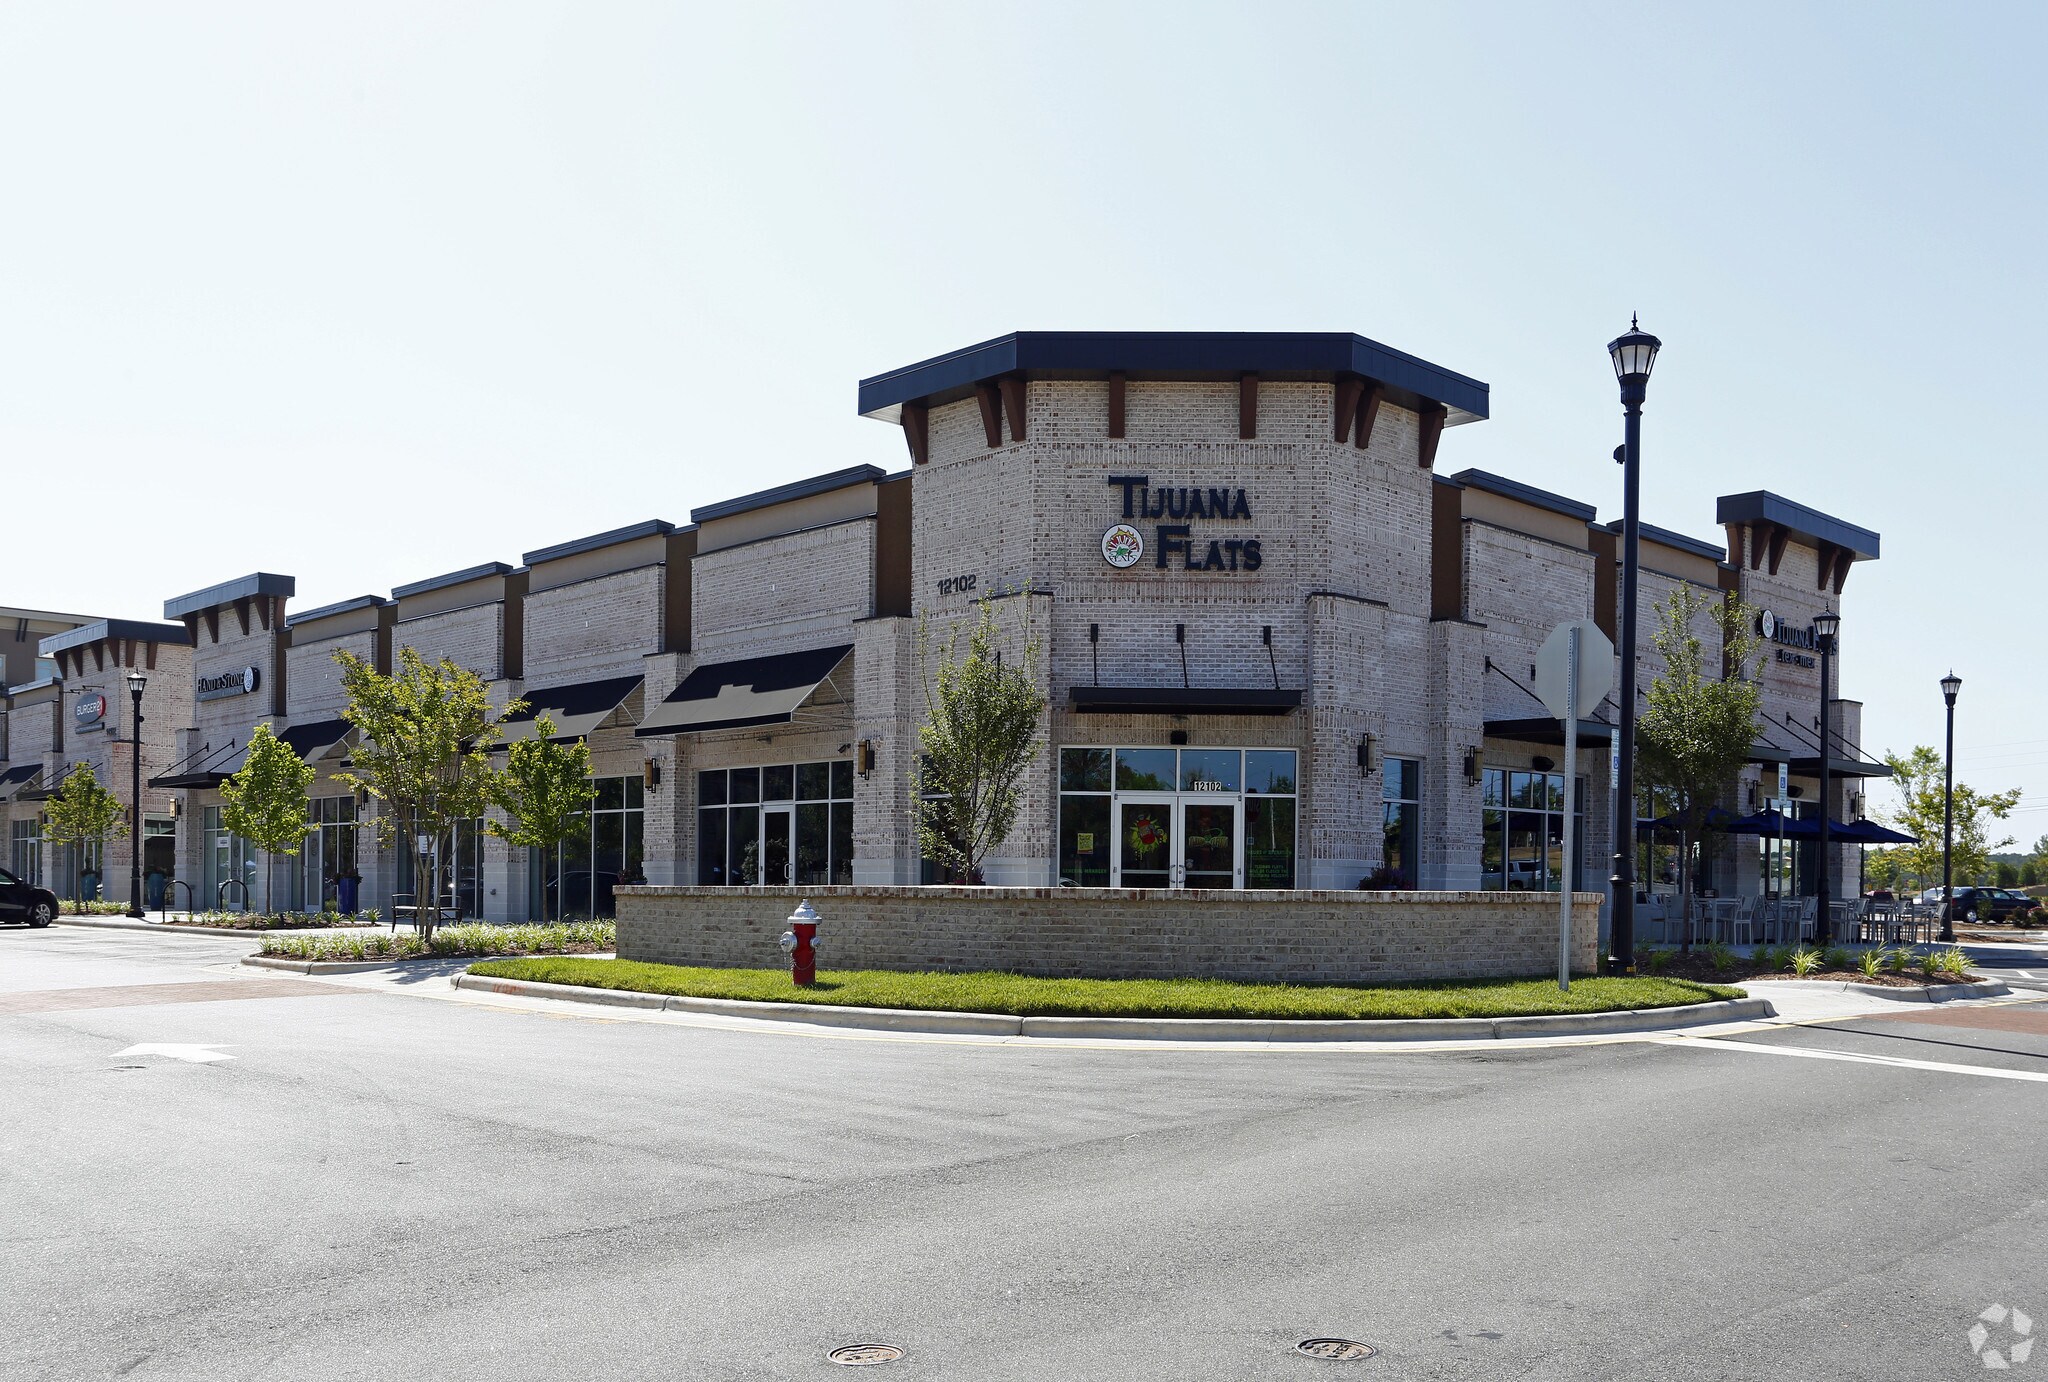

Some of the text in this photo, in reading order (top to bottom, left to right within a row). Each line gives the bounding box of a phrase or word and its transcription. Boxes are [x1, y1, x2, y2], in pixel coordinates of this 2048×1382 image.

[1108, 475, 1251, 520] TIJUANA
[1155, 524, 1262, 571] FLATS
[937, 574, 977, 595] 12102
[1776, 616, 1810, 649] TIJUANA
[197, 677, 216, 693] HAND
[222, 671, 245, 689] STONE
[1195, 781, 1222, 792] 12102
